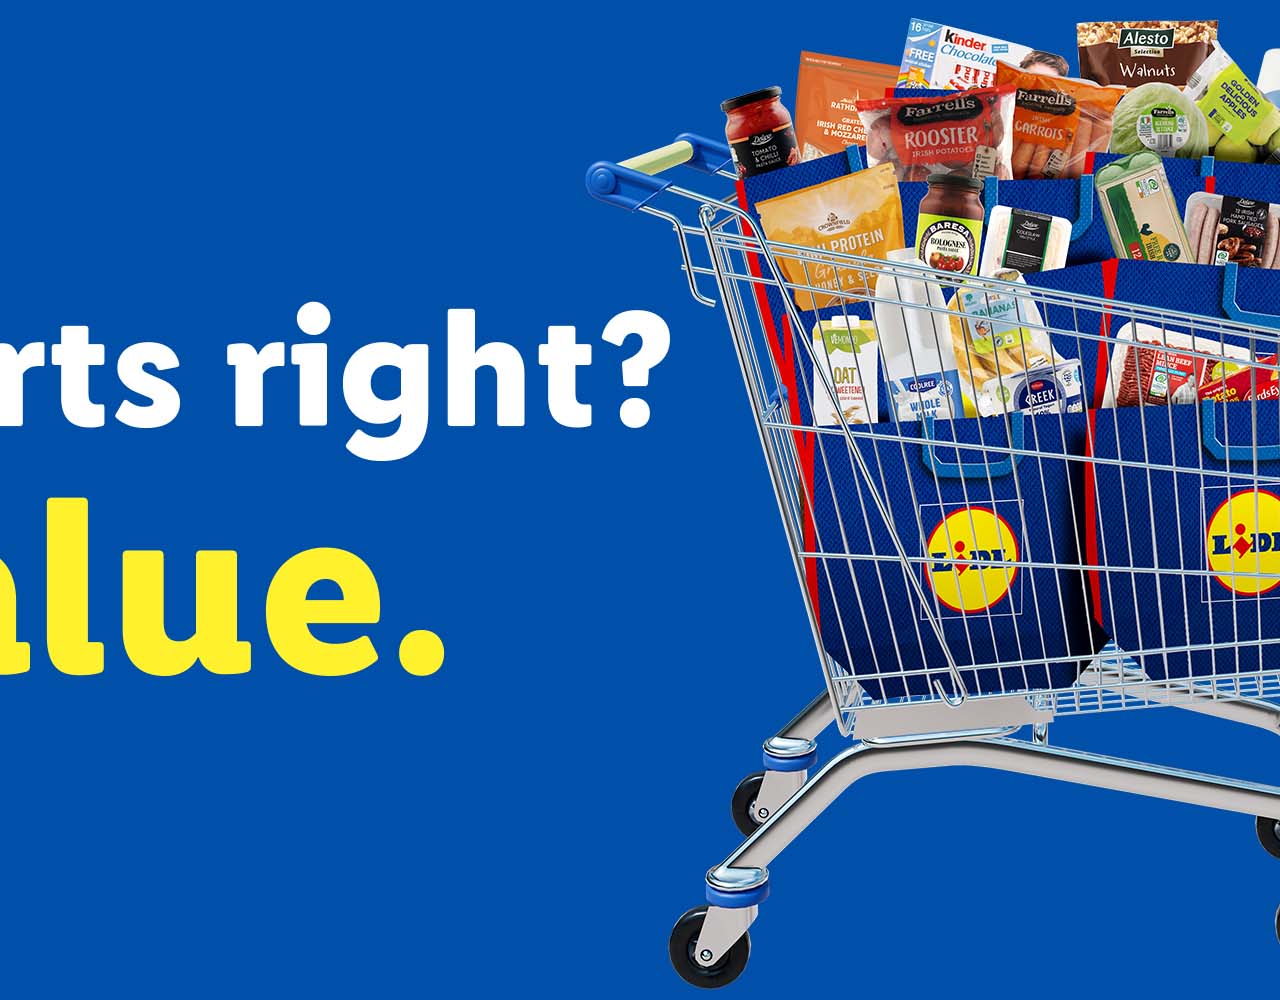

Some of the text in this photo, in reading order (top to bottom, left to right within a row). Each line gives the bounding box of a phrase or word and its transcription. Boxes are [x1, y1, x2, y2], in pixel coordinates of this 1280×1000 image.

[911, 21, 922, 32] 16
[1123, 31, 1169, 45] Alesto
[910, 48, 935, 62] FREE
[1120, 62, 1176, 78] Walnuts
[1221, 82, 1257, 117] DELICIOUS
[1231, 80, 1260, 107] GOLDEN
[1219, 94, 1246, 119] APPLES
[816, 119, 836, 129] IRISH
[837, 122, 852, 132] RED
[905, 126, 978, 149] ROOSTER
[752, 144, 778, 157] TOMATO
[760, 151, 779, 161] CHILLI
[912, 148, 934, 158] IRISH
[929, 221, 970, 237] BARESA
[830, 228, 884, 252] PROTEIN
[930, 238, 966, 248] BOLOGNESE
[834, 366, 856, 384] OAT
